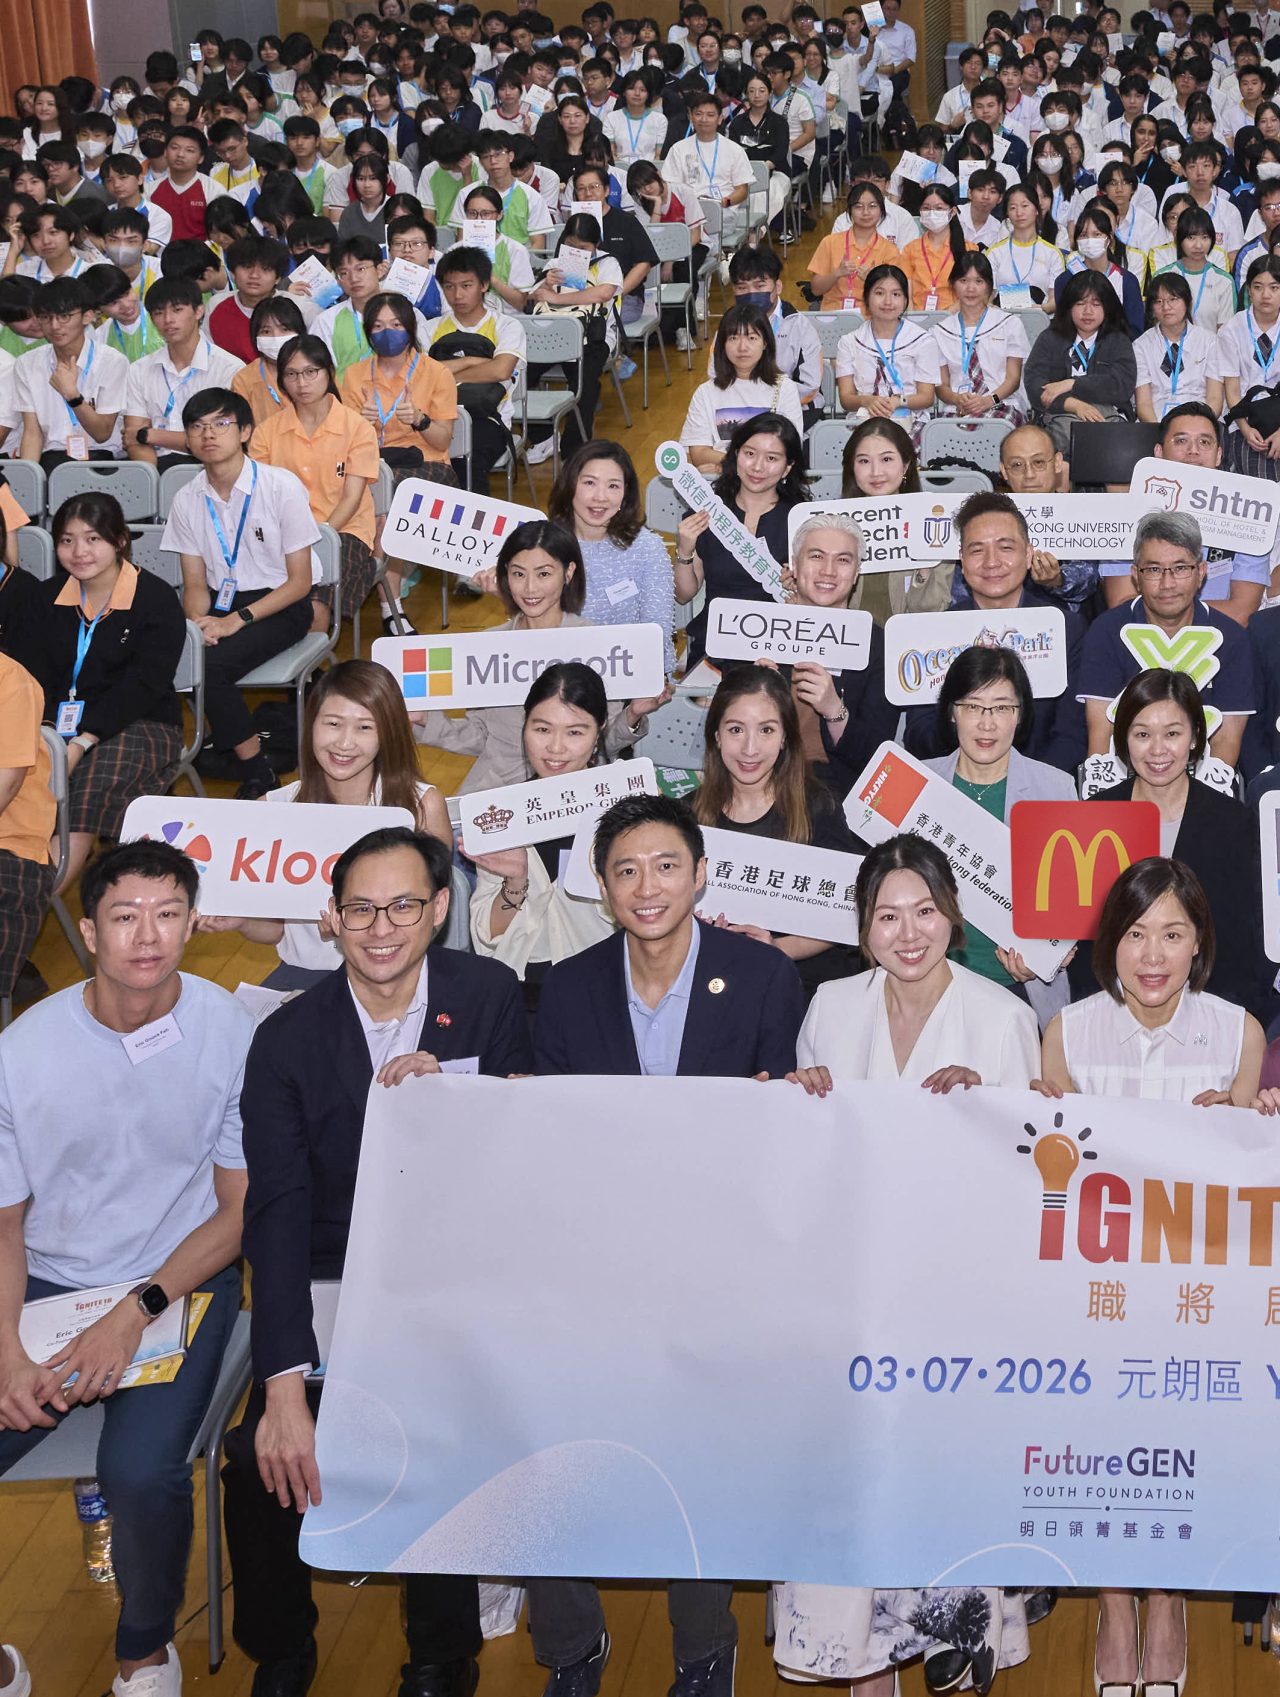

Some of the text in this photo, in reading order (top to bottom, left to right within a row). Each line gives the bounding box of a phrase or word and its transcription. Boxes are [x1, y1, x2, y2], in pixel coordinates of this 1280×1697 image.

[1024, 506, 1054, 519] 大學
[1189, 486, 1273, 523] shtm
[396, 517, 501, 558] DALLOY
[1068, 522, 1134, 533] UNIVERSITY
[1043, 537, 1126, 548] TECHNOLOGY
[432, 547, 484, 567] PARIS
[750, 641, 826, 655] GROUPE
[466, 645, 634, 686] Microft
[930, 674, 946, 689] Hon
[1090, 759, 1117, 783] 認
[526, 774, 645, 813] 英皇集團
[916, 812, 998, 880] 香港青年協會
[715, 860, 857, 903] 香港足球總會
[717, 881, 768, 896] ASSOCIATION
[769, 890, 780, 898] OF
[782, 893, 805, 903] HONG
[806, 897, 831, 909] KONG,
[833, 902, 856, 912] CHINA
[56, 1328, 73, 1339] Eric
[1116, 1356, 1244, 1405] 元朗區
[1023, 1445, 1196, 1480] FutureGEN
[1023, 1487, 1196, 1502] YOUTH FOUNDATION
[1020, 1521, 1194, 1541] 明日領菁基金會
